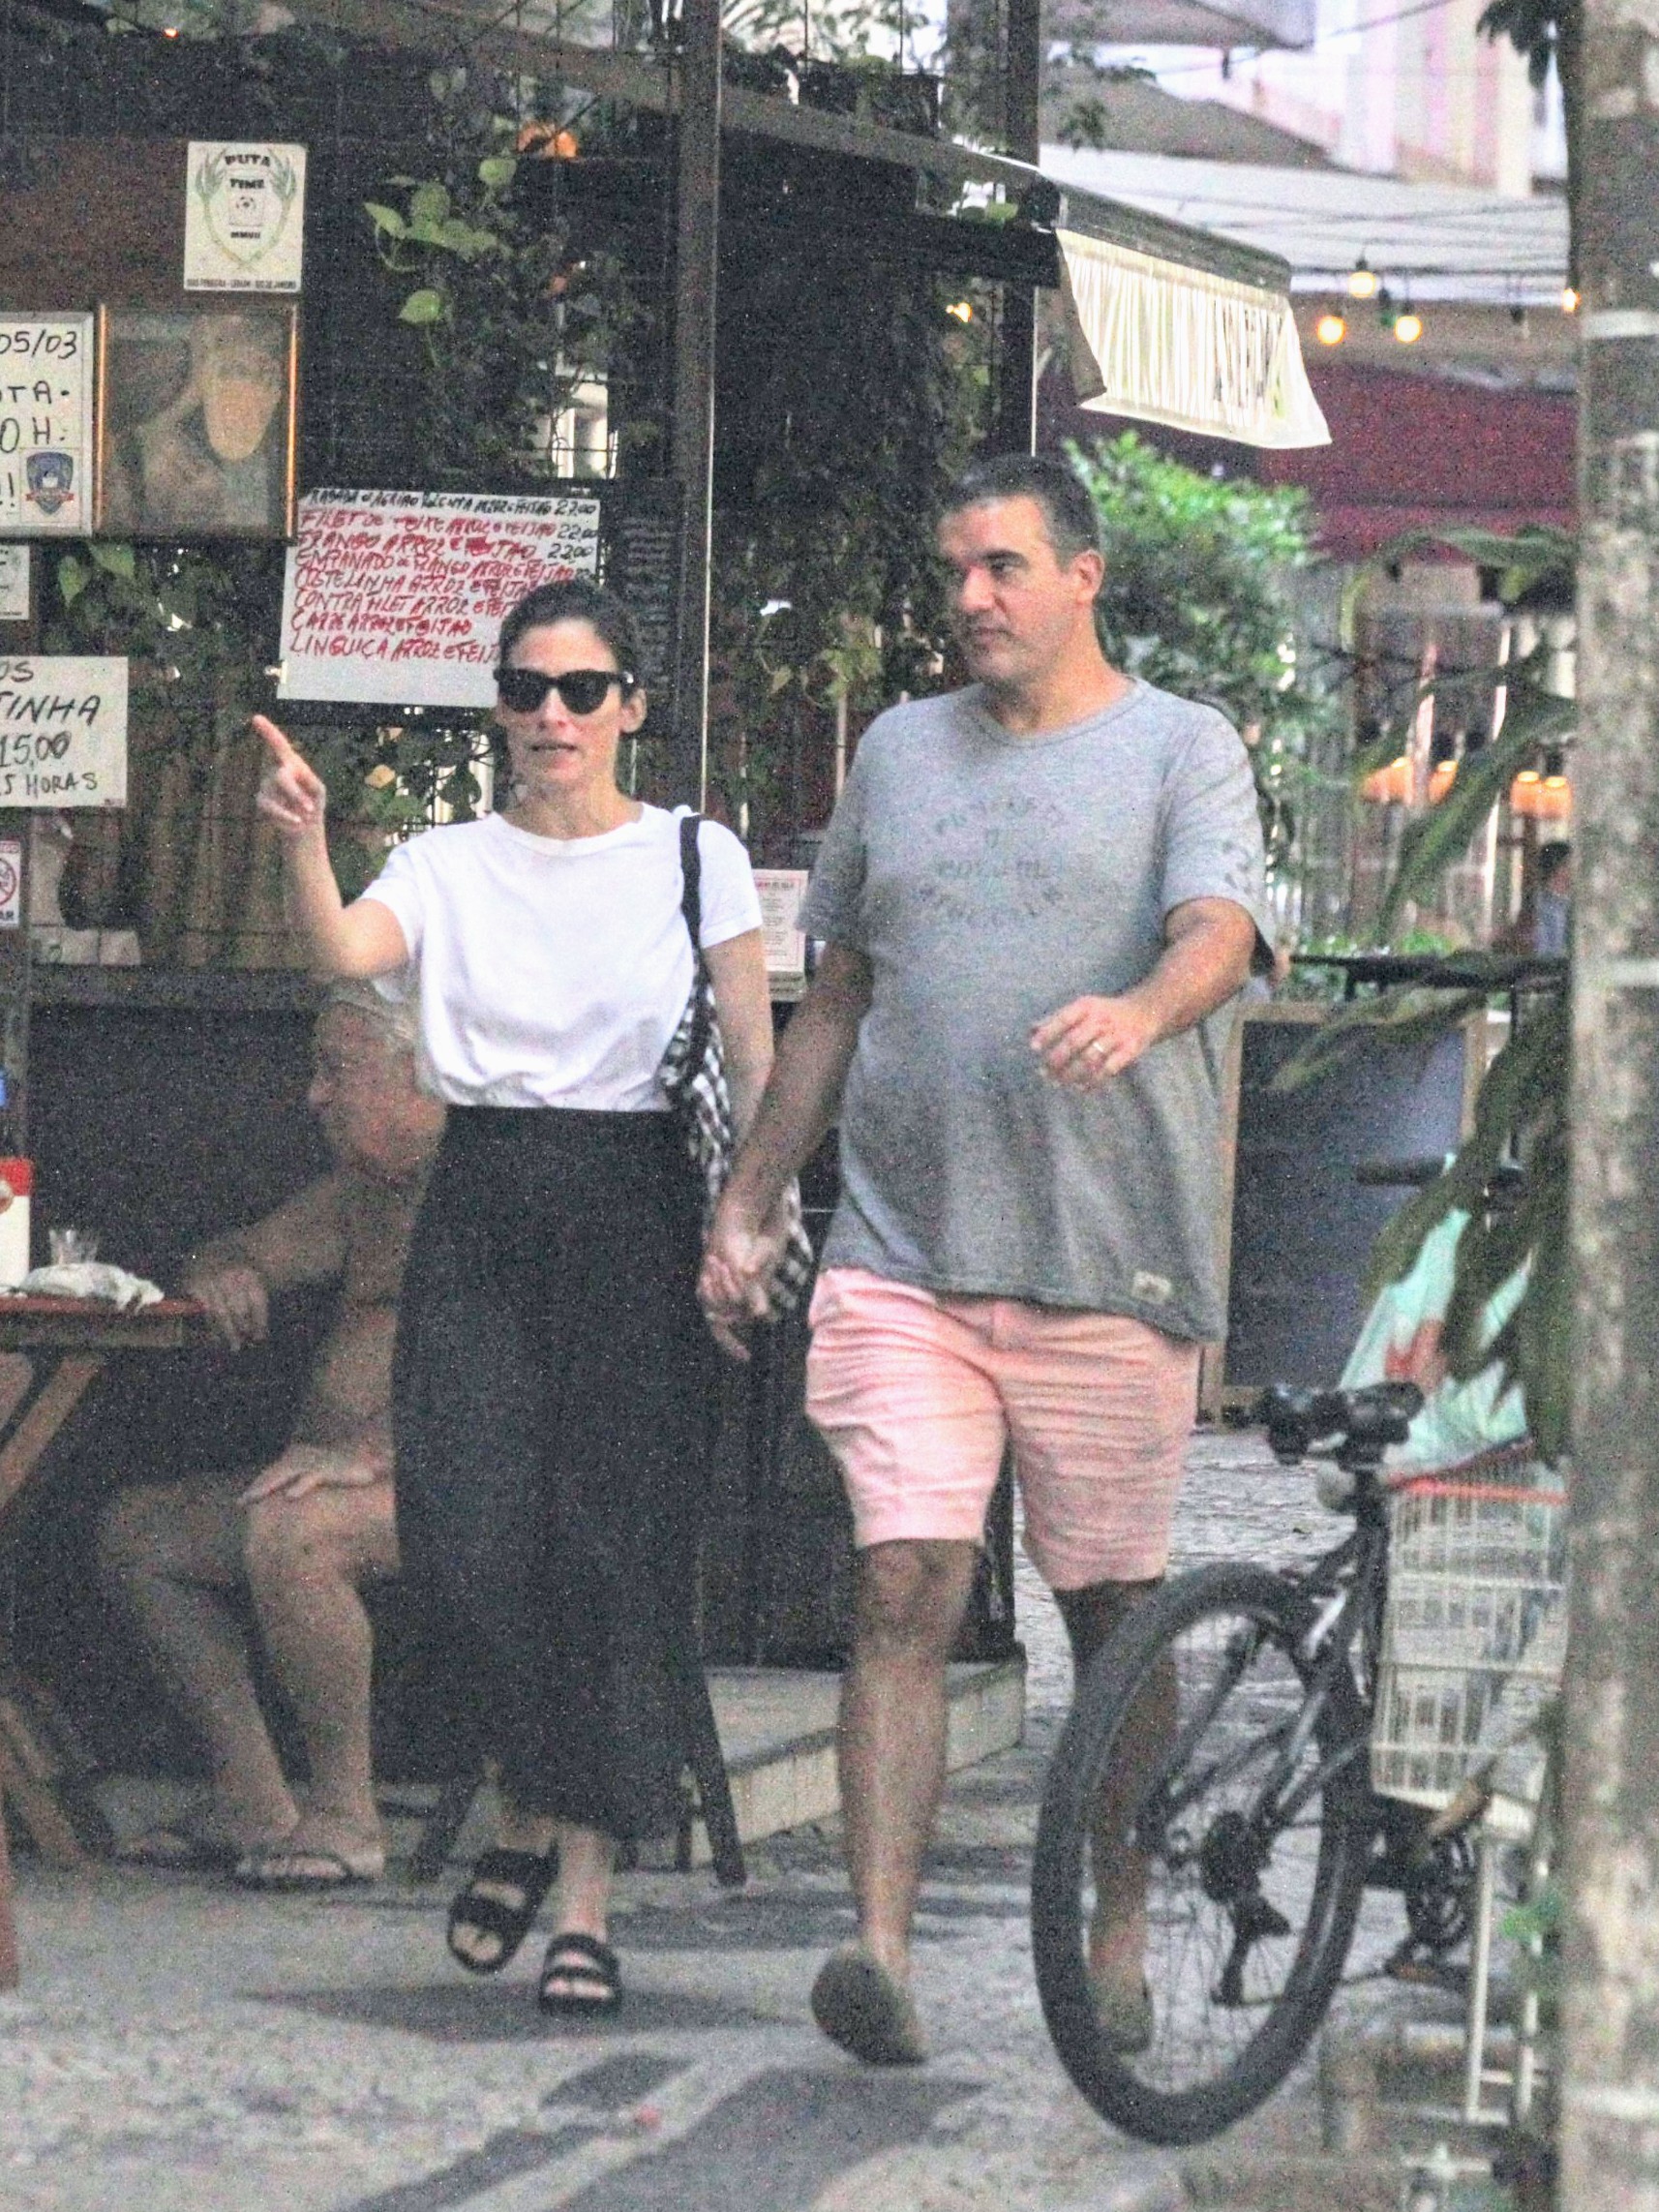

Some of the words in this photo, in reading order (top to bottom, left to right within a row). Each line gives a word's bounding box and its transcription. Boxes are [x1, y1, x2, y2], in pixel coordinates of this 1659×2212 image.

[225, 154, 270, 167] PUTA
[230, 178, 264, 189] TIME
[300, 509, 367, 529] FILET
[296, 531, 380, 550] FRANGO
[382, 534, 445, 556] ARROZ
[294, 548, 394, 572] EMPANADO
[294, 566, 407, 593] COSTELINHA
[407, 575, 467, 596] ARROZ
[293, 587, 363, 612] CONTRA
[409, 597, 468, 617] ARROZ
[25, 772, 98, 799] HORAS
